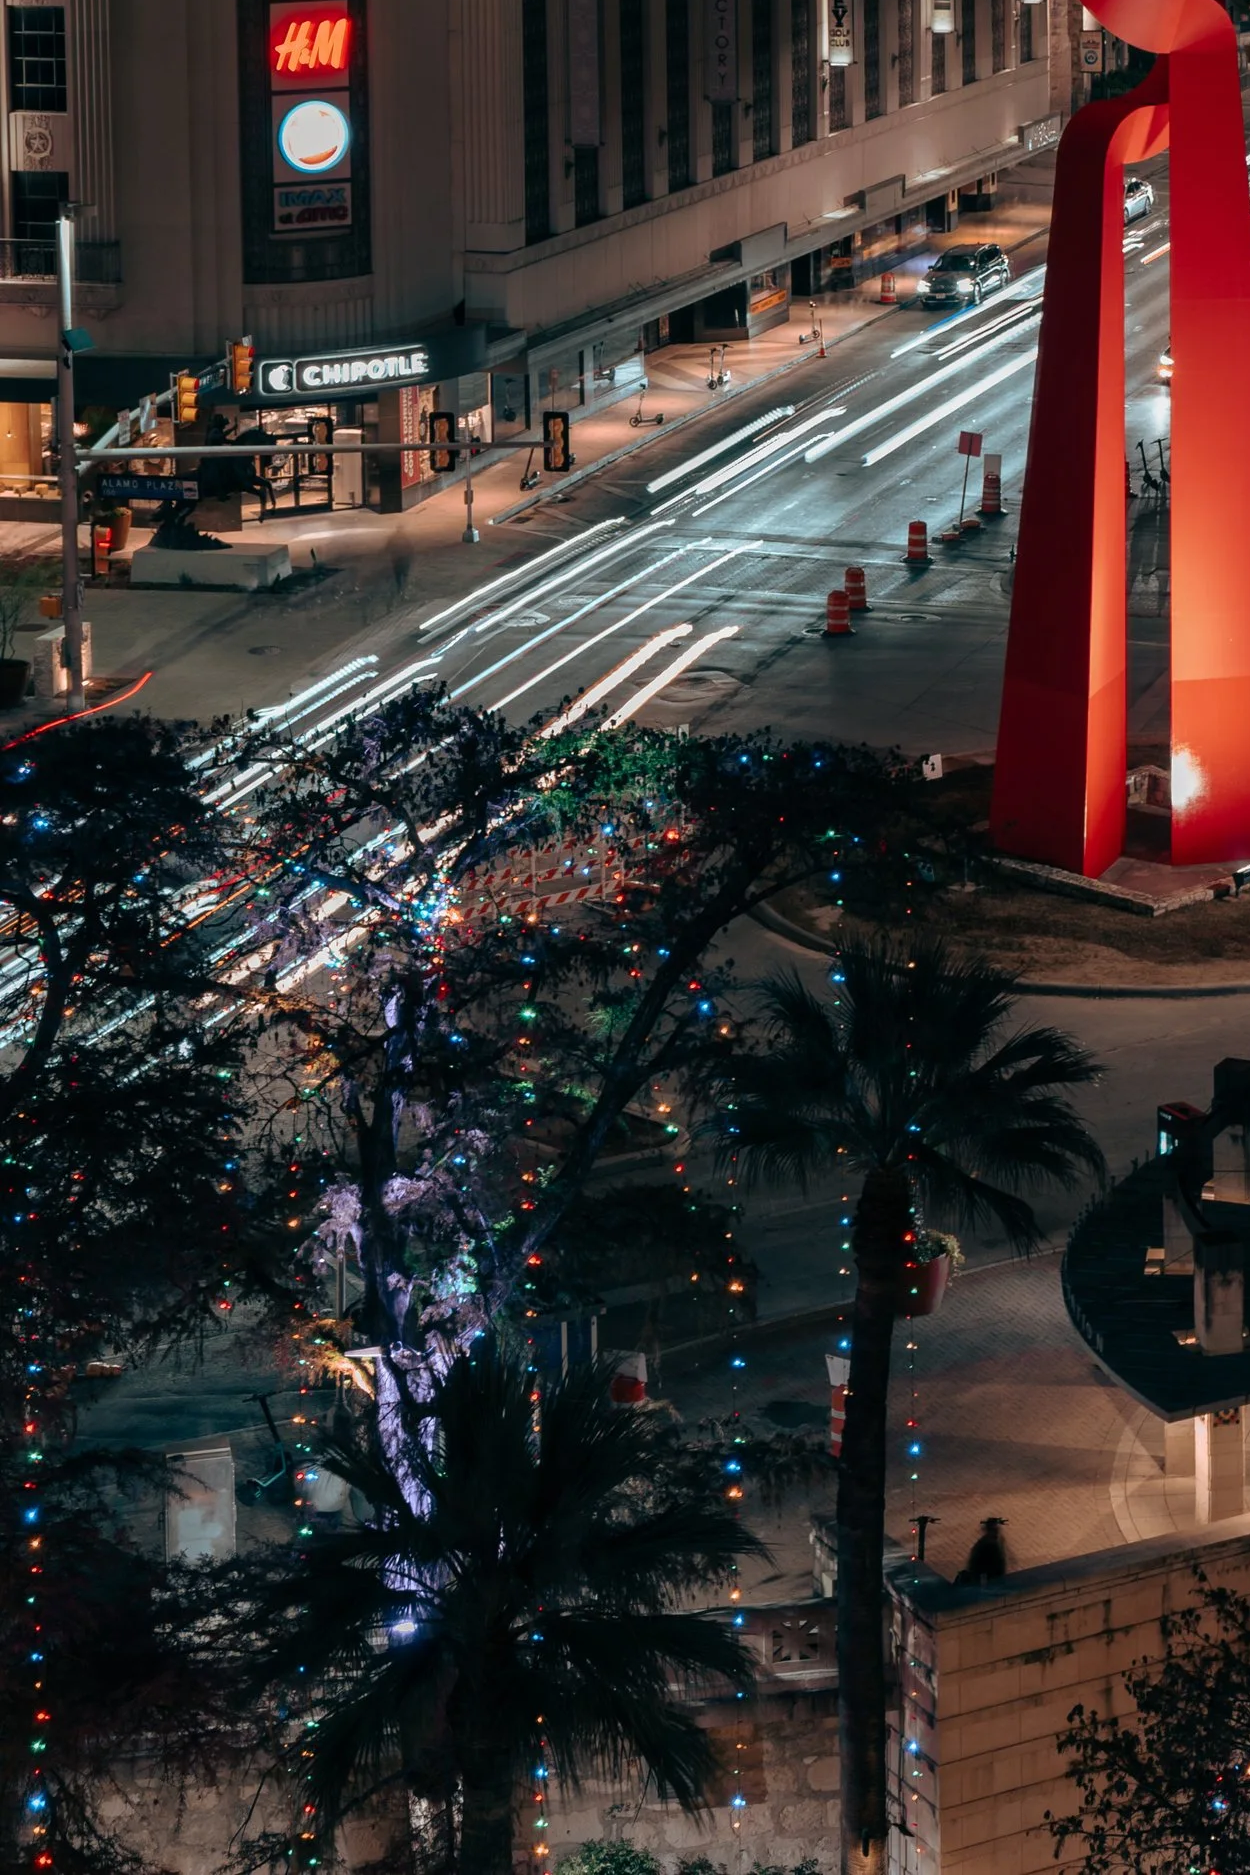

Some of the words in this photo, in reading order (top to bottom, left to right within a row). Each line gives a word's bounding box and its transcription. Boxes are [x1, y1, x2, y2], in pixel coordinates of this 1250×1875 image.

[829, 29, 850, 37] GOLF
[275, 18, 347, 72] H&M
[829, 38, 850, 47] CLUB
[279, 188, 346, 208] IMAX
[303, 353, 428, 387] CHIPOTLE
[102, 478, 139, 489] ALAMO
